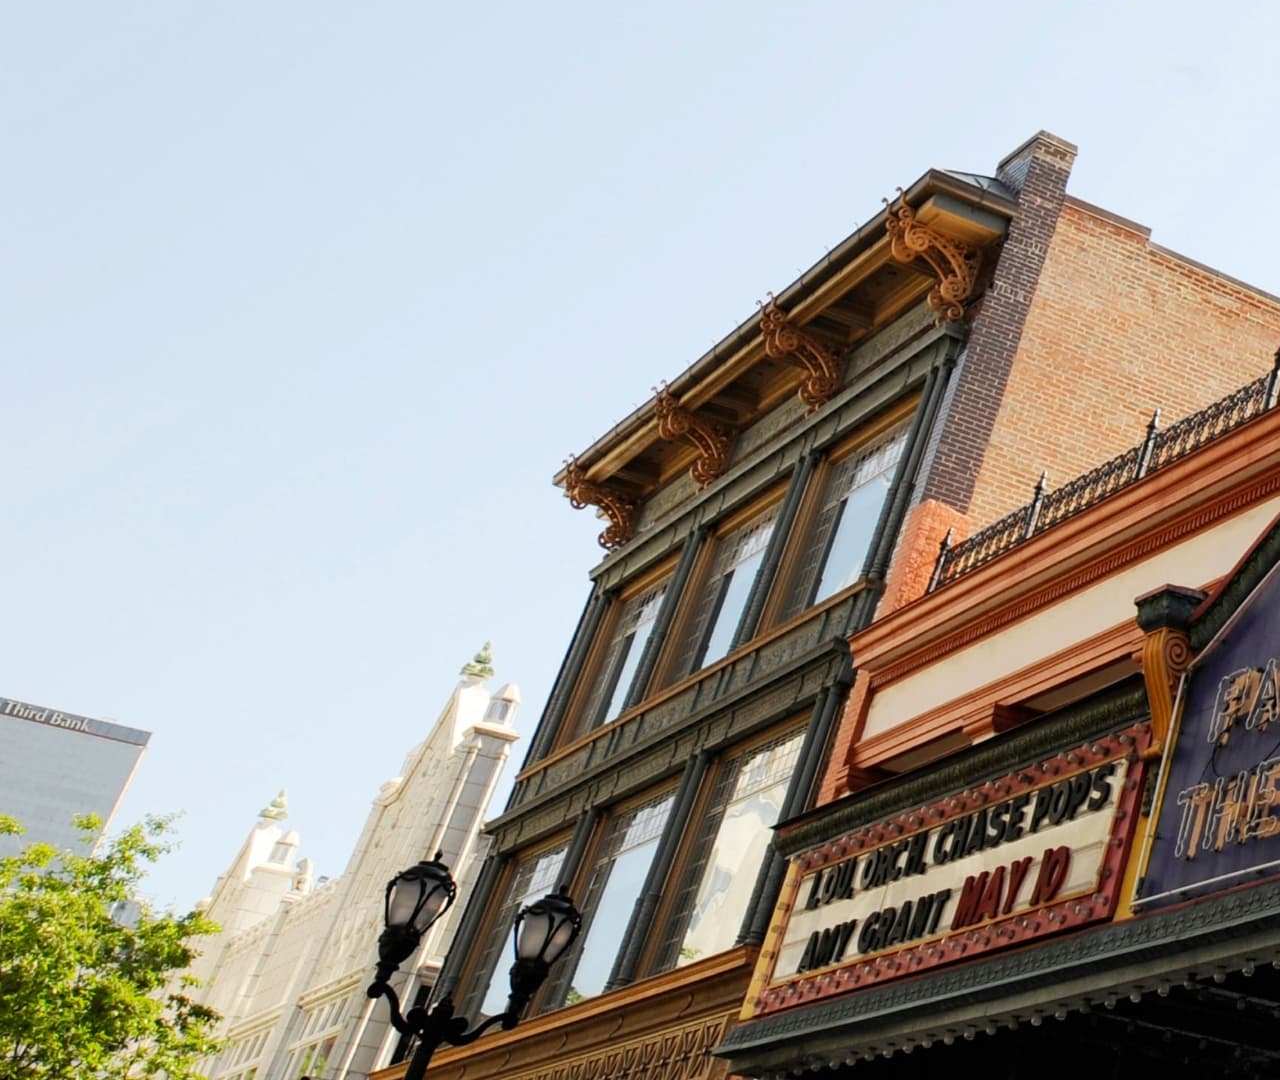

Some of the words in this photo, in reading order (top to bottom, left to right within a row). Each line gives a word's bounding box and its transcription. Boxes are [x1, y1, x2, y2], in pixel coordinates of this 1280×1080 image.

[4, 701, 48, 721] Third
[50, 712, 89, 732] Bank
[933, 792, 1031, 865] CHASE
[1029, 763, 1116, 834] POPS
[796, 918, 858, 974] AMY
[858, 888, 952, 954] GRANT
[951, 856, 1033, 931] MAY
[1029, 846, 1071, 906] 10
